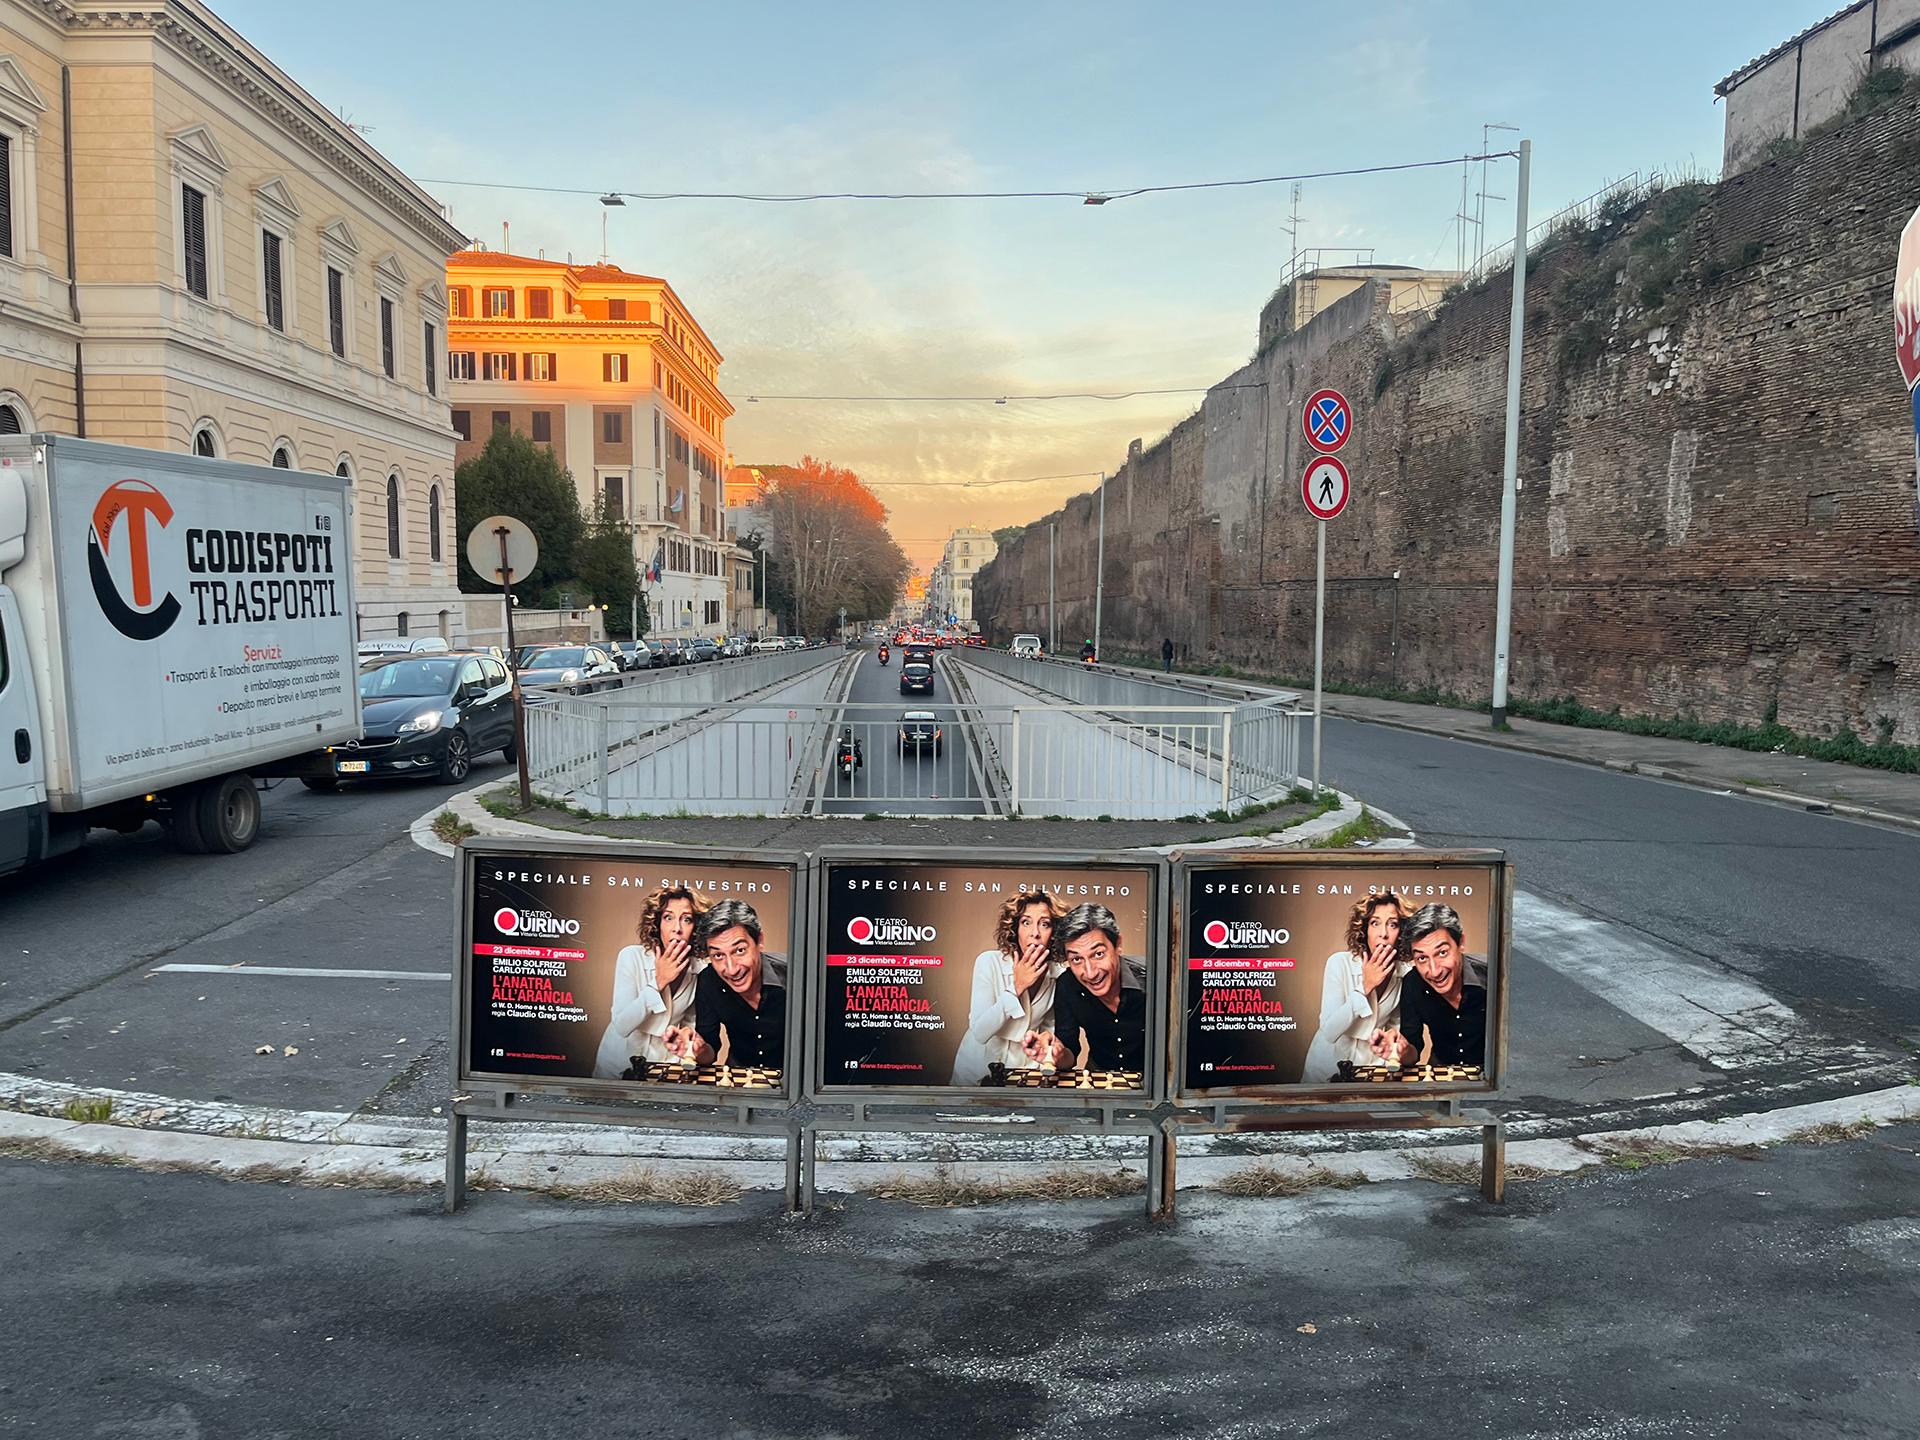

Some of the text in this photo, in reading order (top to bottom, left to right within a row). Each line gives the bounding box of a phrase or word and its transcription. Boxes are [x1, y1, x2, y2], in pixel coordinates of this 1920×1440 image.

[186, 528, 333, 573] CODISPOTI
[190, 580, 337, 625] TRASPORTI
[170, 668, 208, 684] Trasporti
[210, 666, 217, 679] &
[218, 663, 250, 677] Traslochi
[252, 663, 264, 673] con
[250, 677, 290, 691] imballaggio
[291, 676, 304, 685] con
[320, 668, 340, 680] mobile
[222, 700, 255, 713] Deposito
[277, 693, 294, 704] brevi
[300, 690, 318, 699] lungo
[319, 685, 341, 696] termine
[495, 871, 772, 893] SPECIALE SAN SILVESTRO
[848, 880, 1130, 896] SPECIALE SAN SILVESTRO
[1205, 884, 1473, 895] SPECIALE SAN SILVESTRO
[520, 909, 552, 919] TEATRO
[494, 907, 580, 936] QUIRINO
[874, 918, 908, 926] TEATRO
[1230, 921, 1262, 929] TEATRO
[847, 916, 937, 945] QUIRINO
[1204, 920, 1290, 949] QUIRINO
[504, 946, 540, 955] dicembre
[553, 950, 585, 958] gennaio
[493, 958, 566, 969] EMILIO SOLFRIZZI
[847, 956, 857, 964] 23
[858, 956, 896, 964] dicembre
[909, 957, 941, 966] gennaio
[1263, 960, 1294, 969] gennaio
[493, 966, 567, 977] CARLOTTA NATOLI
[846, 968, 922, 977] EMILIO SOLFRIZZI
[493, 975, 553, 990] L'ANATRA
[846, 976, 923, 984] CARLOTTA NATOLI
[492, 987, 574, 1004] ALL'ARANCIA
[846, 985, 908, 998] L'ANATRA
[1202, 988, 1262, 1001] L'ANATRA
[845, 998, 930, 1012] ALL'ARANCIA
[1201, 1001, 1283, 1014] ALL'ARANCIA
[507, 1009, 537, 1018] Claudio
[538, 1011, 557, 1021] Greg
[558, 1012, 588, 1022] Gregori
[861, 1020, 891, 1028] Claudio
[893, 1021, 913, 1029] Greg
[915, 1021, 945, 1030] Gregori
[1216, 1022, 1246, 1030] Claudio
[1247, 1022, 1266, 1031] Greg
[1268, 1022, 1297, 1031] Gregori
